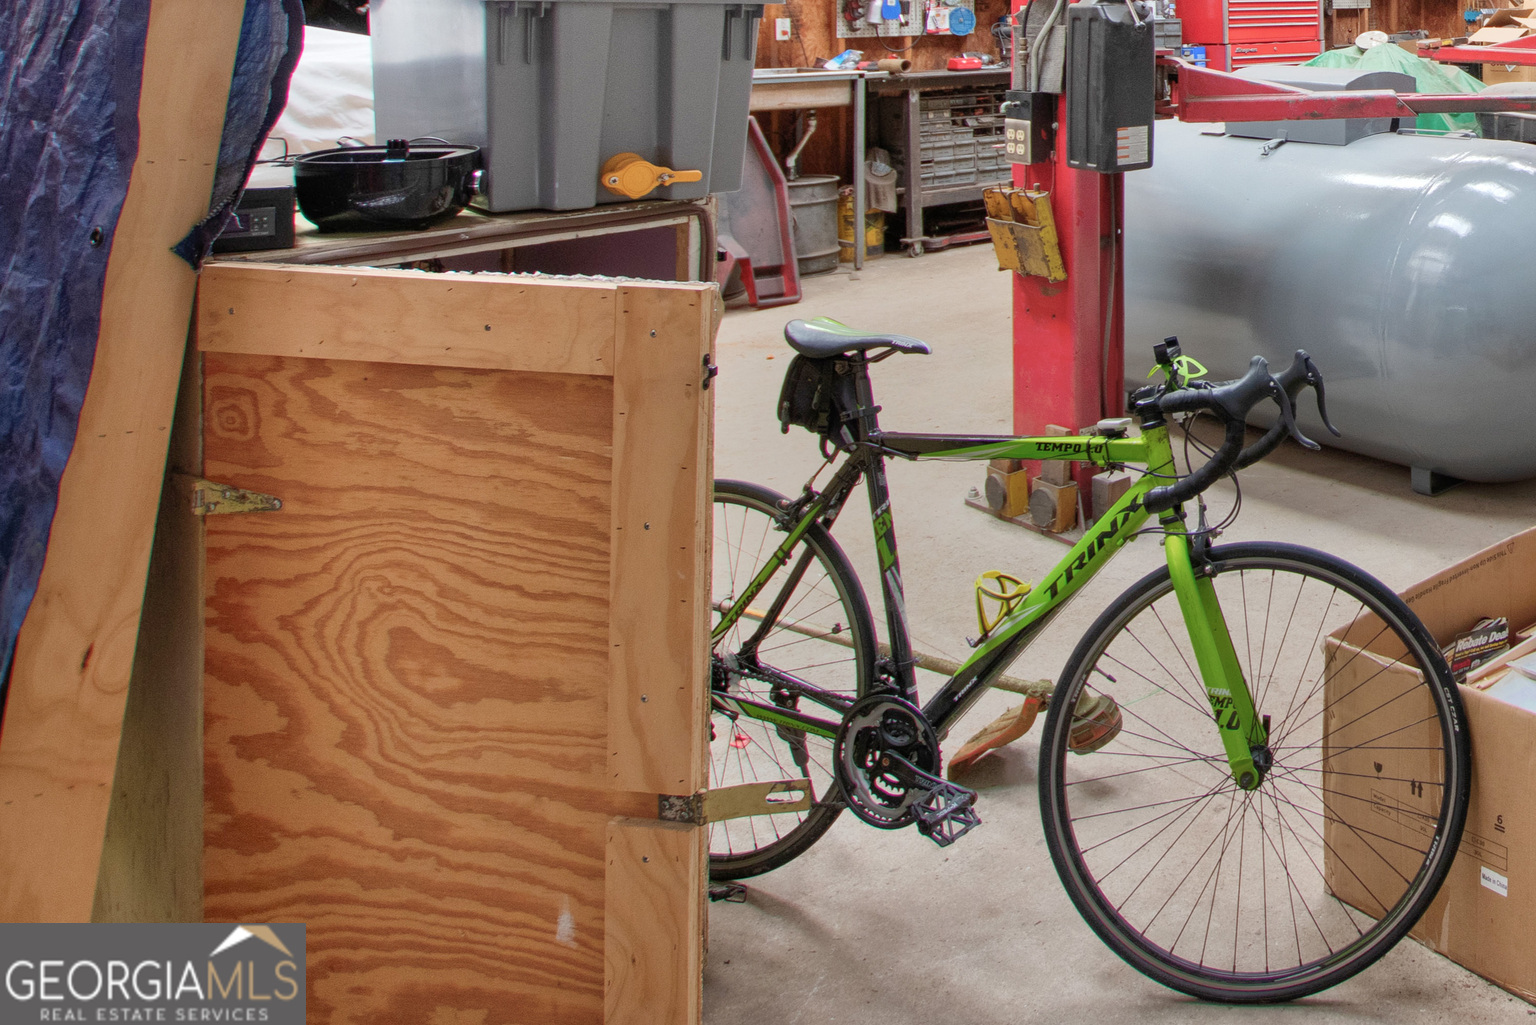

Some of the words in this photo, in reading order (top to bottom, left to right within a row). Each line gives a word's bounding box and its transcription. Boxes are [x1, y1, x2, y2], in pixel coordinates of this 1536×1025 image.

[1035, 442, 1082, 454] TEMPO
[1043, 492, 1143, 601] TRINX
[953, 675, 978, 702] TRINX
[1206, 686, 1232, 696] TRIN
[1496, 814, 1503, 824] 6
